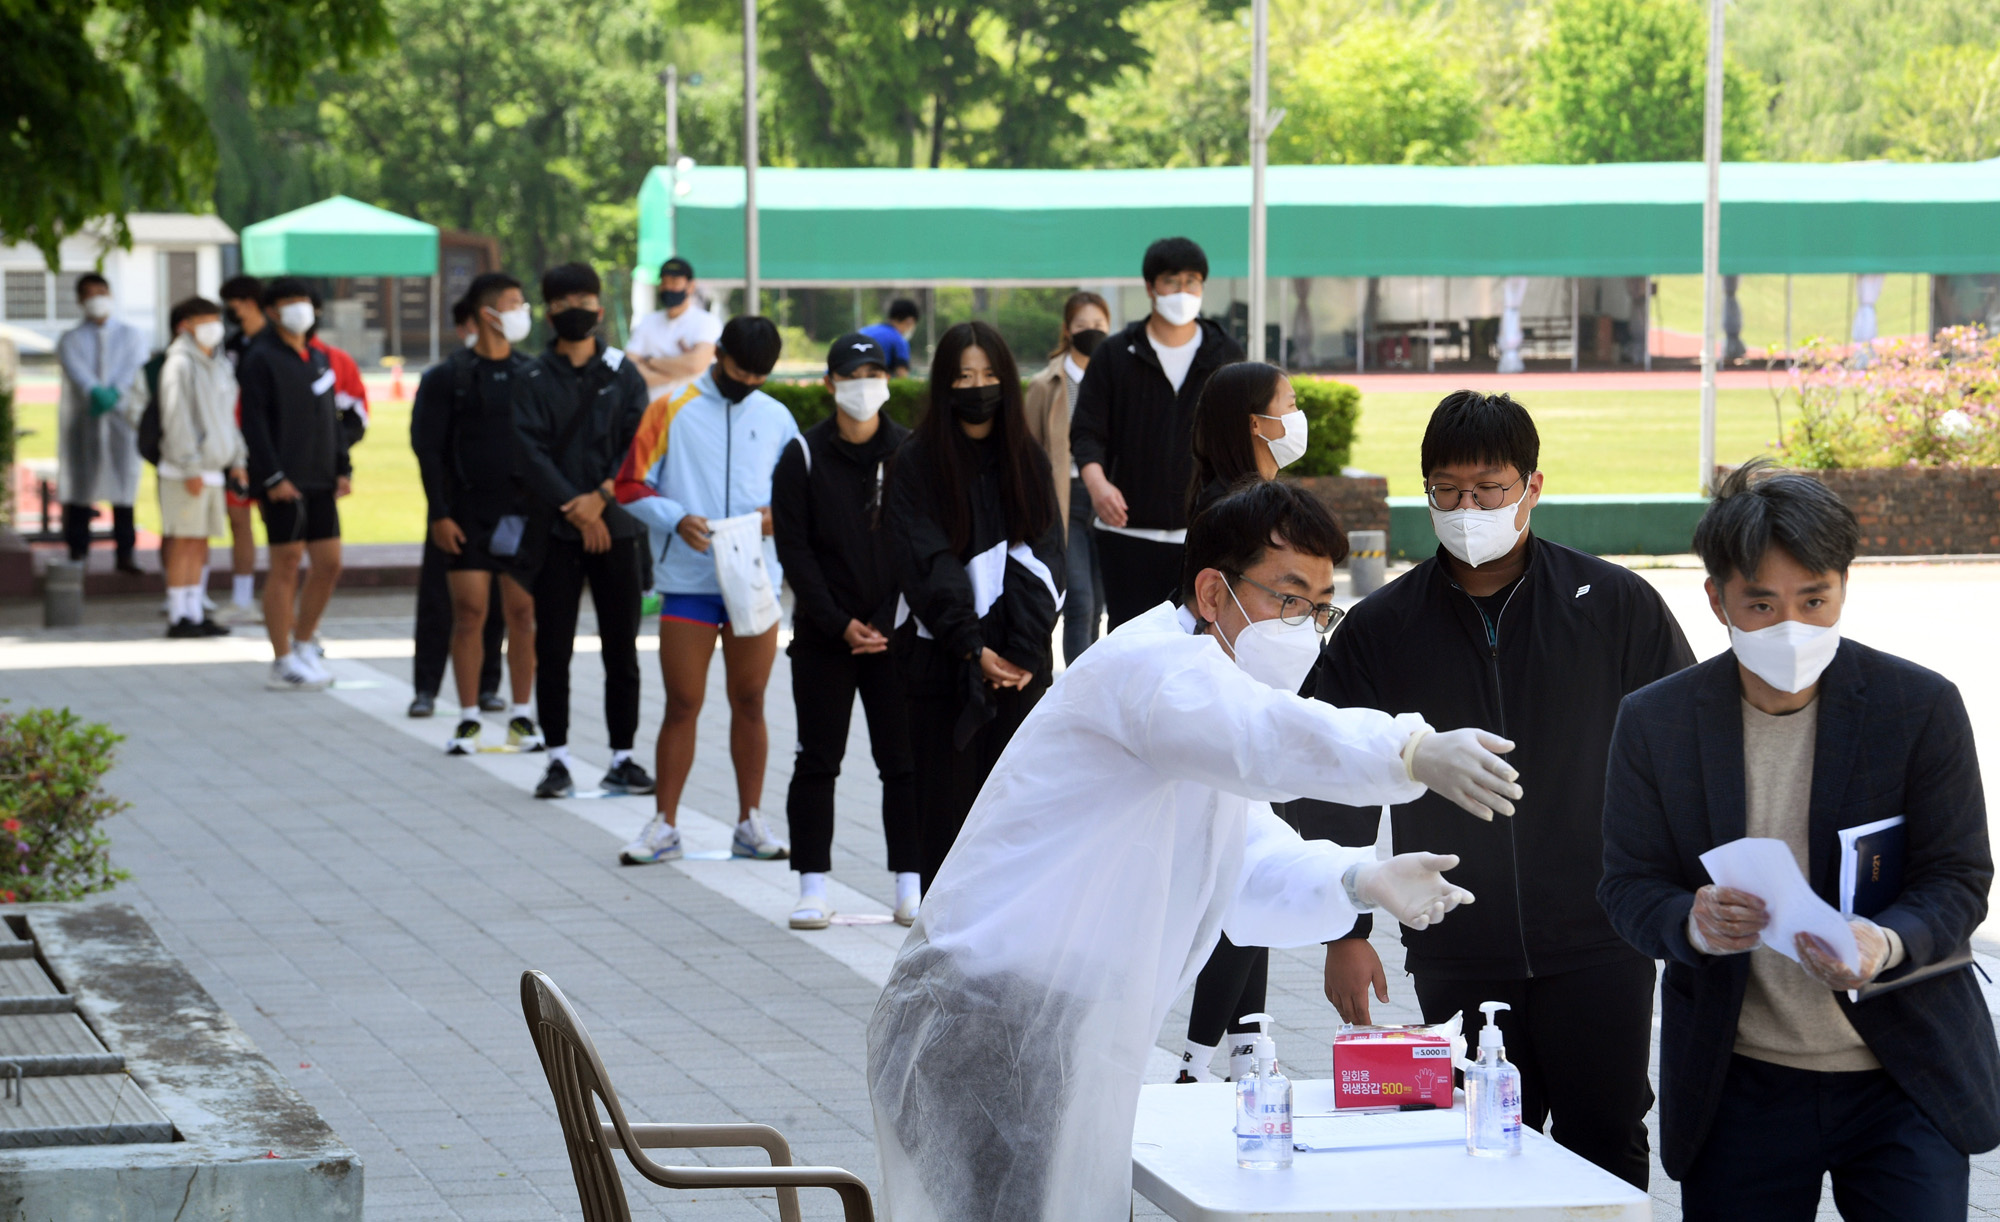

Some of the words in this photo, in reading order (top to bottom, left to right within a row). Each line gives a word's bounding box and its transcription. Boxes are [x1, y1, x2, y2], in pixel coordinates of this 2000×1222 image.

[1341, 1070, 1370, 1082] 일회용
[1342, 1082, 1381, 1095] 위생장갑
[1381, 1082, 1403, 1095] 500
